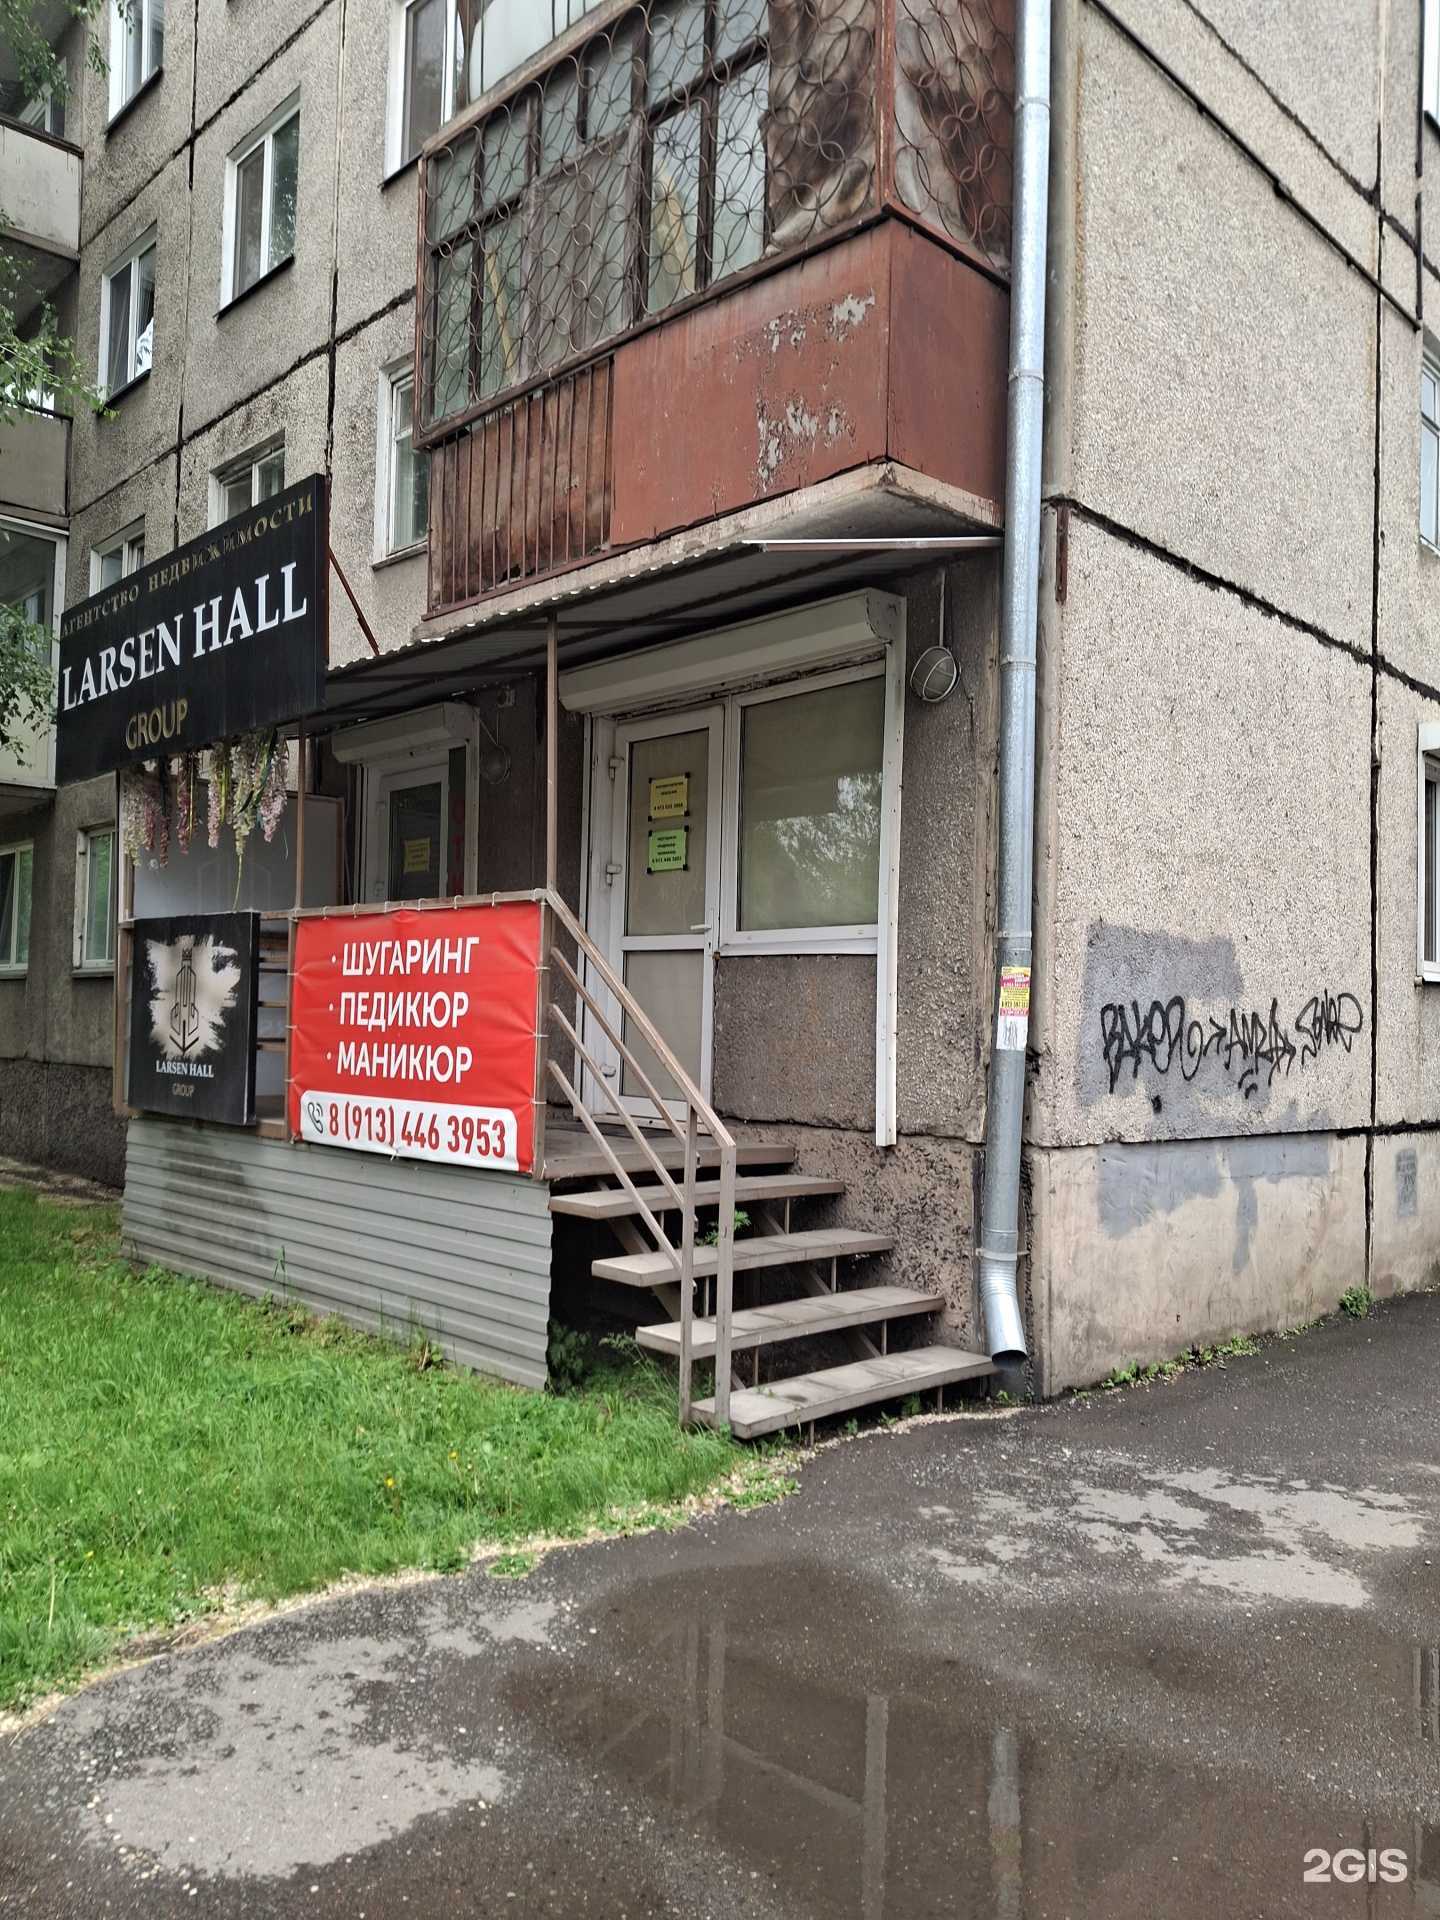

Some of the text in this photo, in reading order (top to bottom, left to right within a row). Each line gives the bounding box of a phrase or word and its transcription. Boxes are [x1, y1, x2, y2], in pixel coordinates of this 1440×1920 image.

[62, 493, 313, 637] АГЕНТСТВО НЕДВИЖИМОСТИ
[62, 561, 307, 712] LARSEN HALL
[125, 698, 188, 750] GROUP
[342, 936, 480, 977] ШУГАРИНГ
[339, 991, 470, 1033] ПЕДИКЮР
[155, 1060, 215, 1078] LARSEN HALL
[336, 1041, 473, 1084] МАНИКЮР
[329, 1101, 506, 1159] 8 (913) 446 3953
